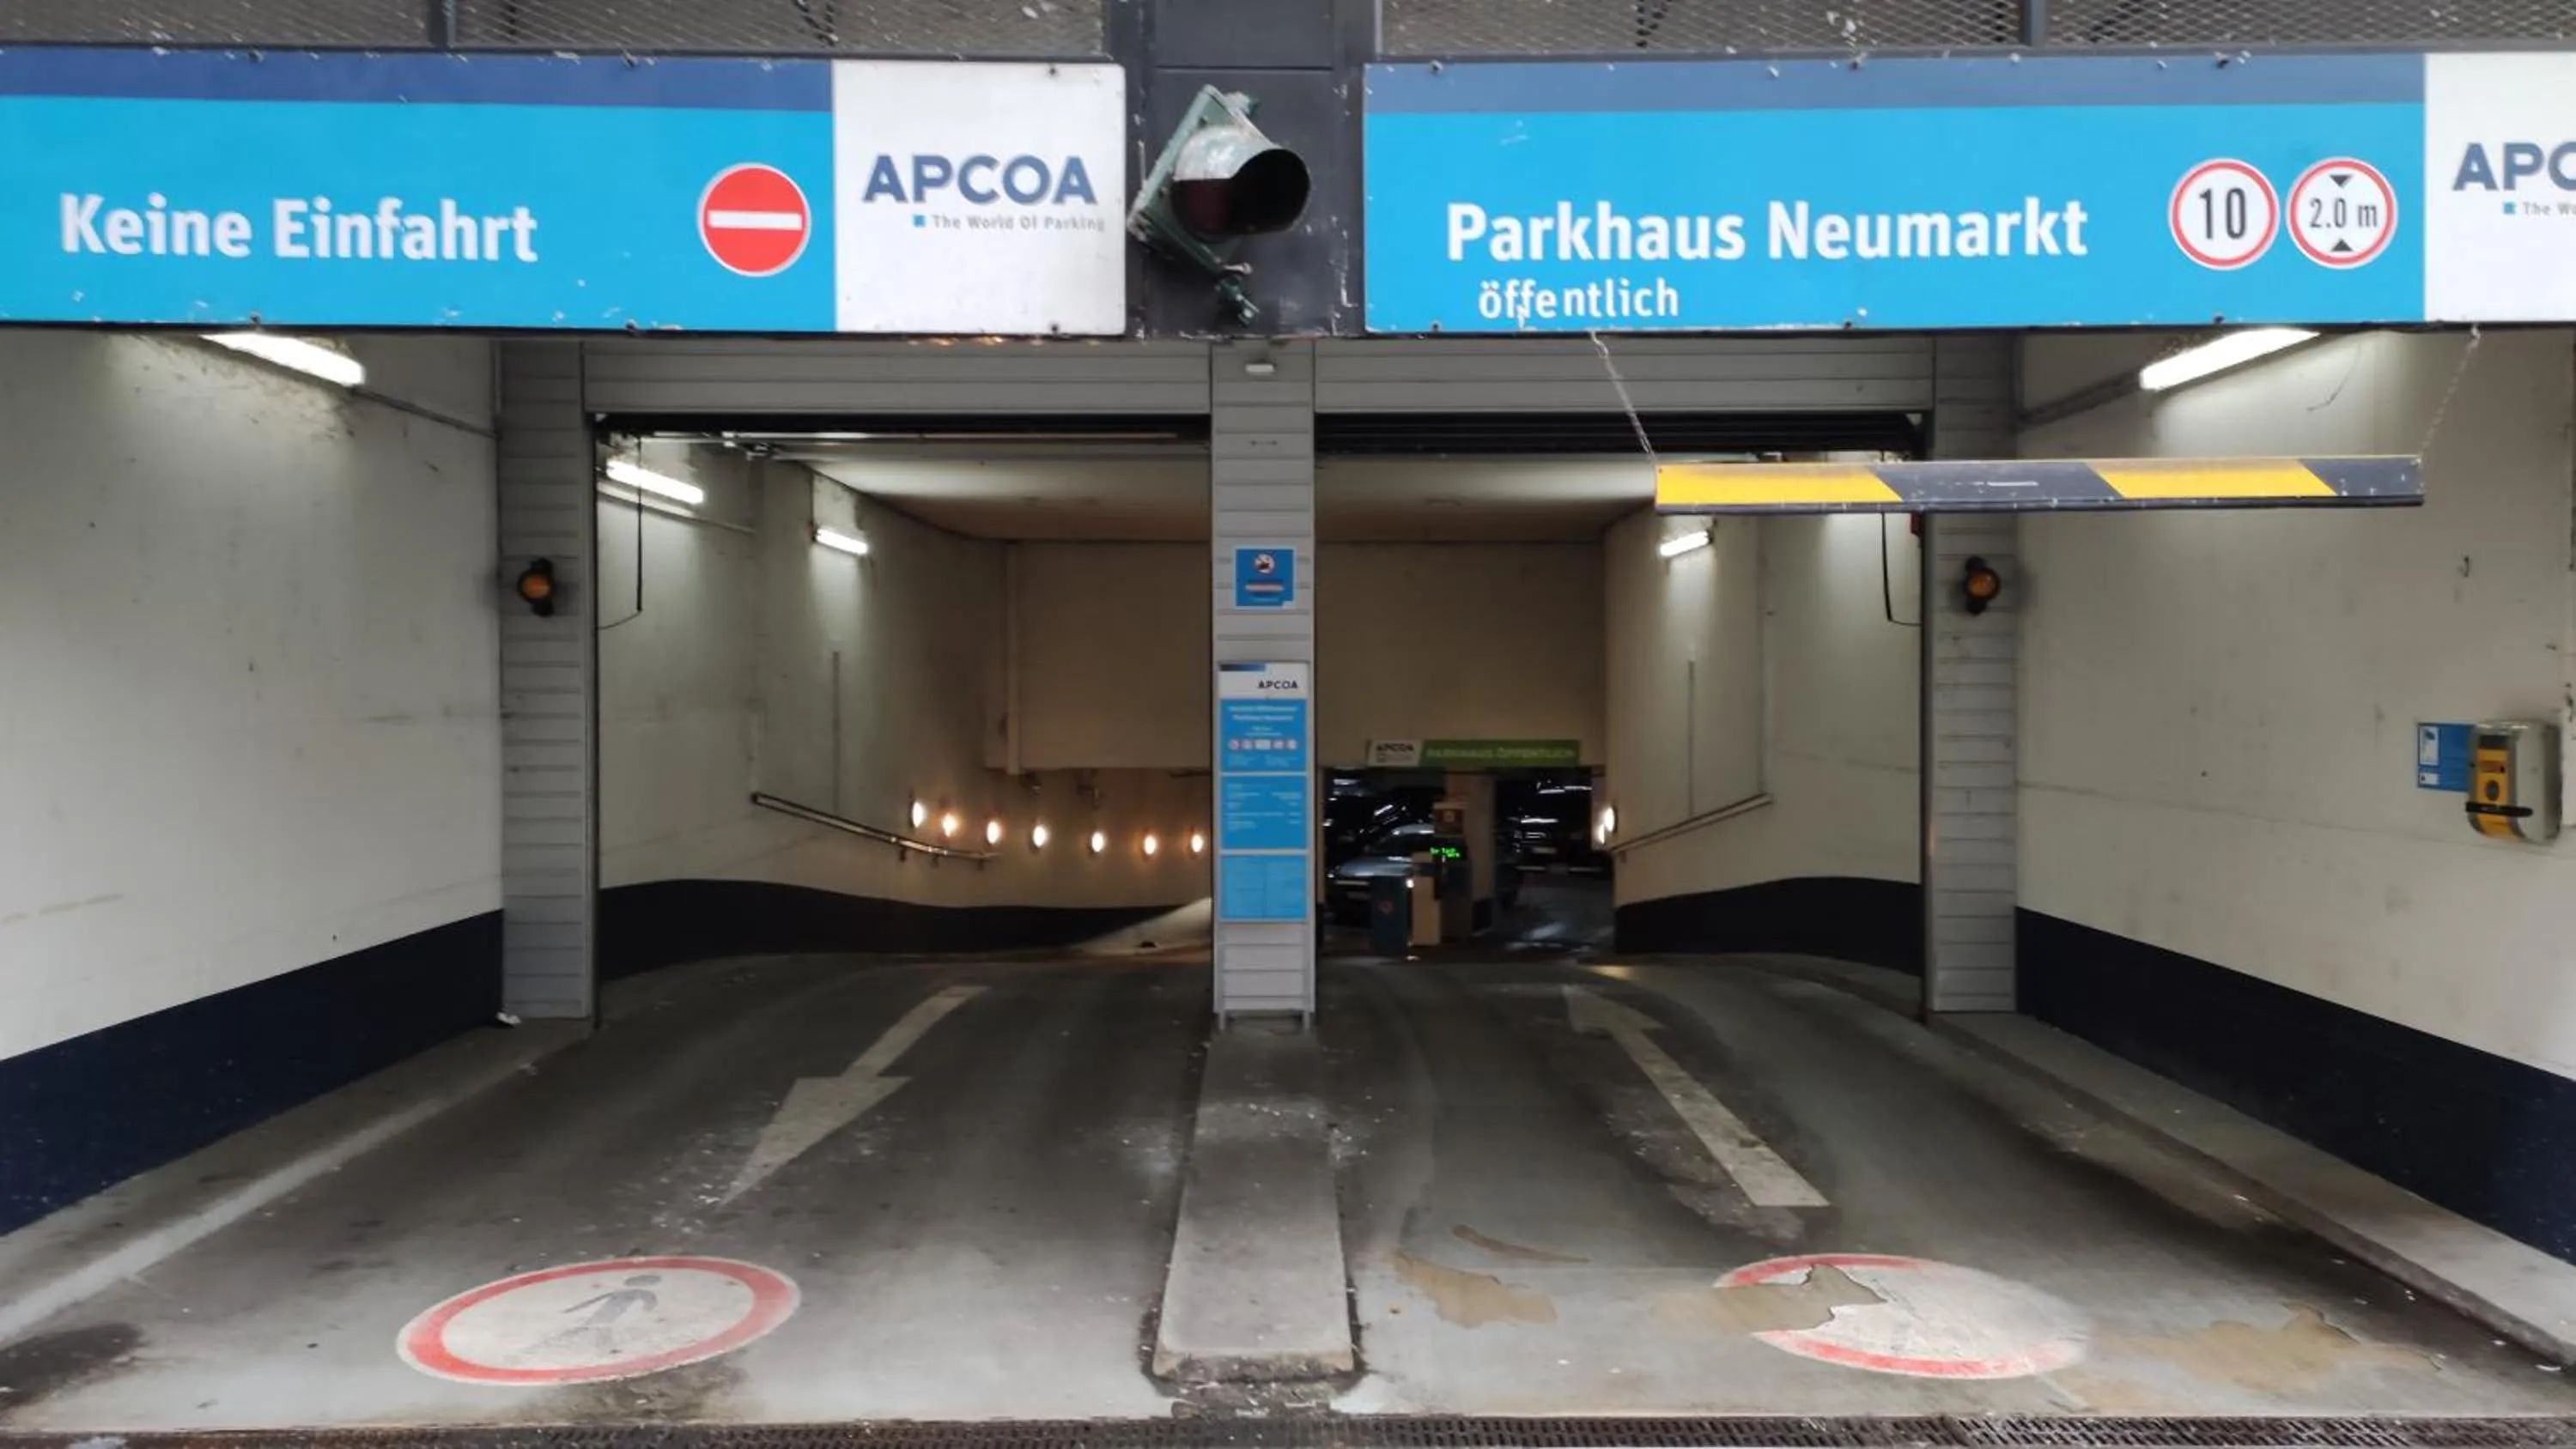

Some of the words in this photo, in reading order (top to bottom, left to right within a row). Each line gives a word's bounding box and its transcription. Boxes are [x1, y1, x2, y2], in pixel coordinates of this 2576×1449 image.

[862, 154, 1097, 205] APCOA
[59, 192, 252, 258] Keine
[273, 196, 538, 262] Einfahrt
[933, 215, 960, 229] The
[967, 215, 1013, 230] World
[1043, 215, 1105, 233] Parking
[2199, 188, 2247, 240] 10
[2309, 198, 2347, 228] 2.0
[2358, 204, 2378, 228] m
[2523, 201, 2550, 216] The
[1446, 200, 1745, 262] Parkhaus
[1768, 197, 2087, 261] Neumarkt
[1478, 279, 1679, 320] öffentlich
[1258, 680, 1298, 689] APCOA
